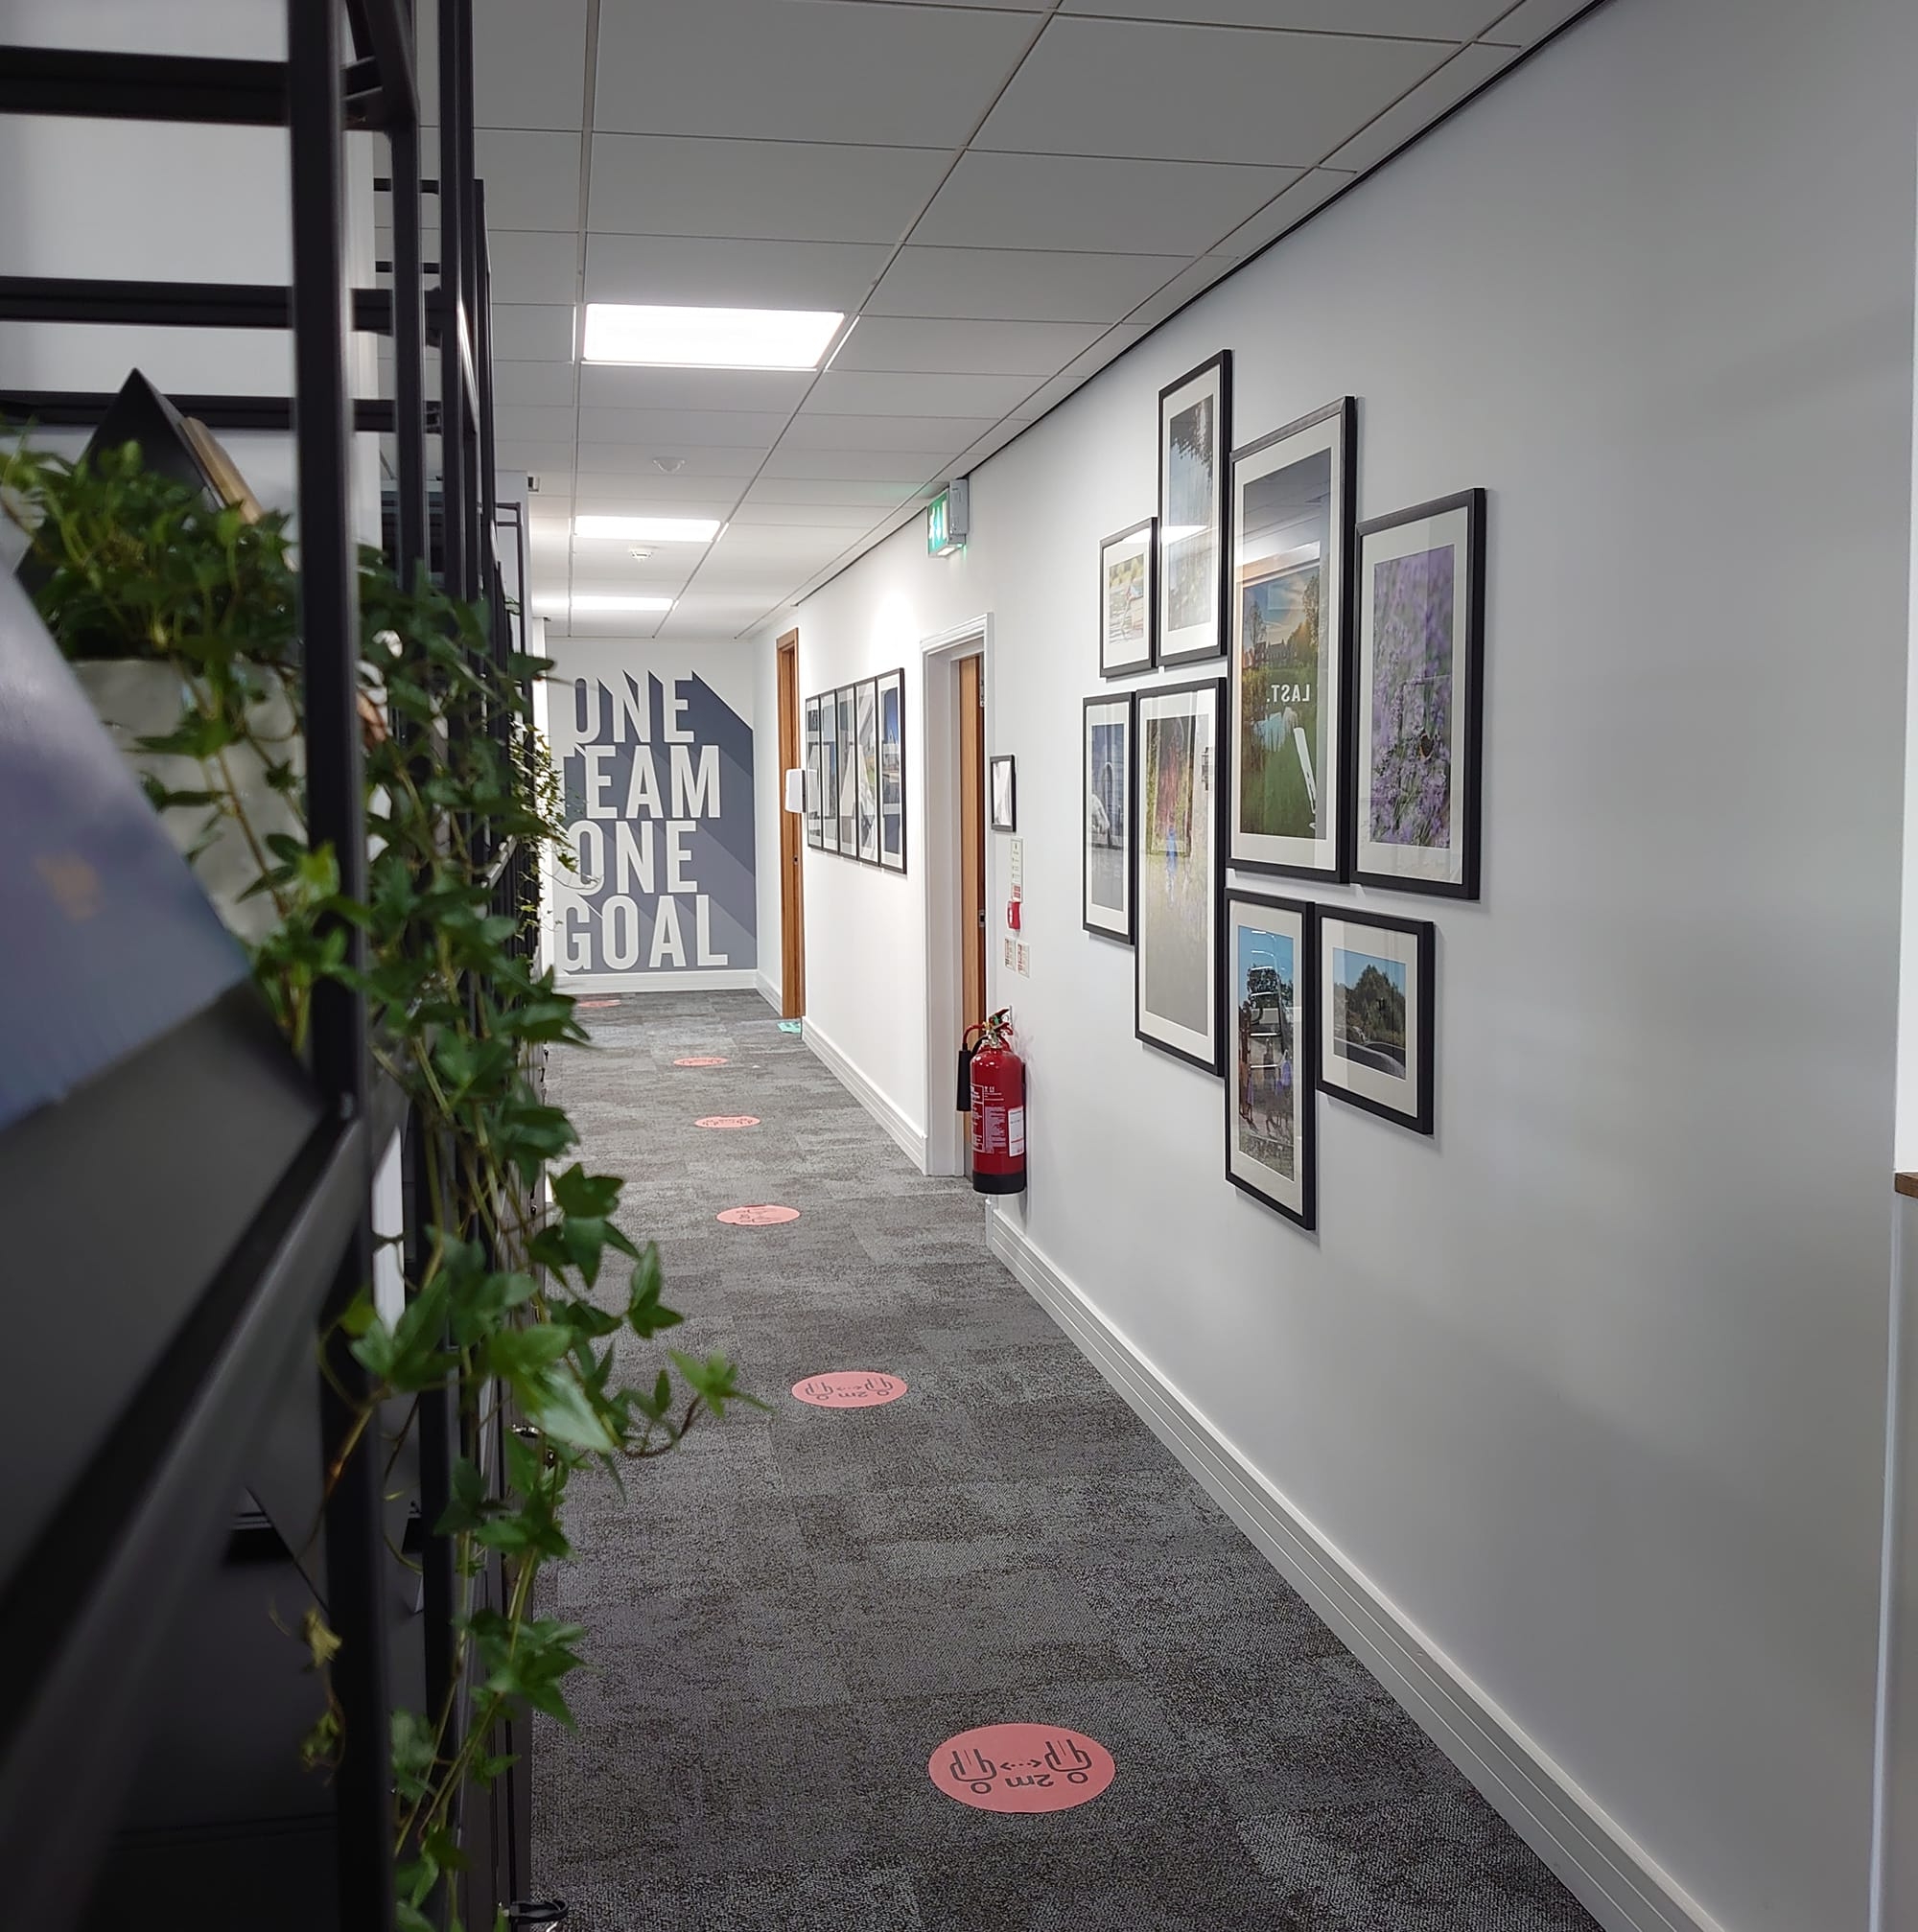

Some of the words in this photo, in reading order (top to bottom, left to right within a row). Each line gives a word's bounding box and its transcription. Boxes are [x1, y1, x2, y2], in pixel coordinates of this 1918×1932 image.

[564, 668, 694, 744] ONE
[565, 820, 698, 896] ONE
[553, 894, 729, 971] GOAL
[1004, 1774, 1055, 1788] 2m
